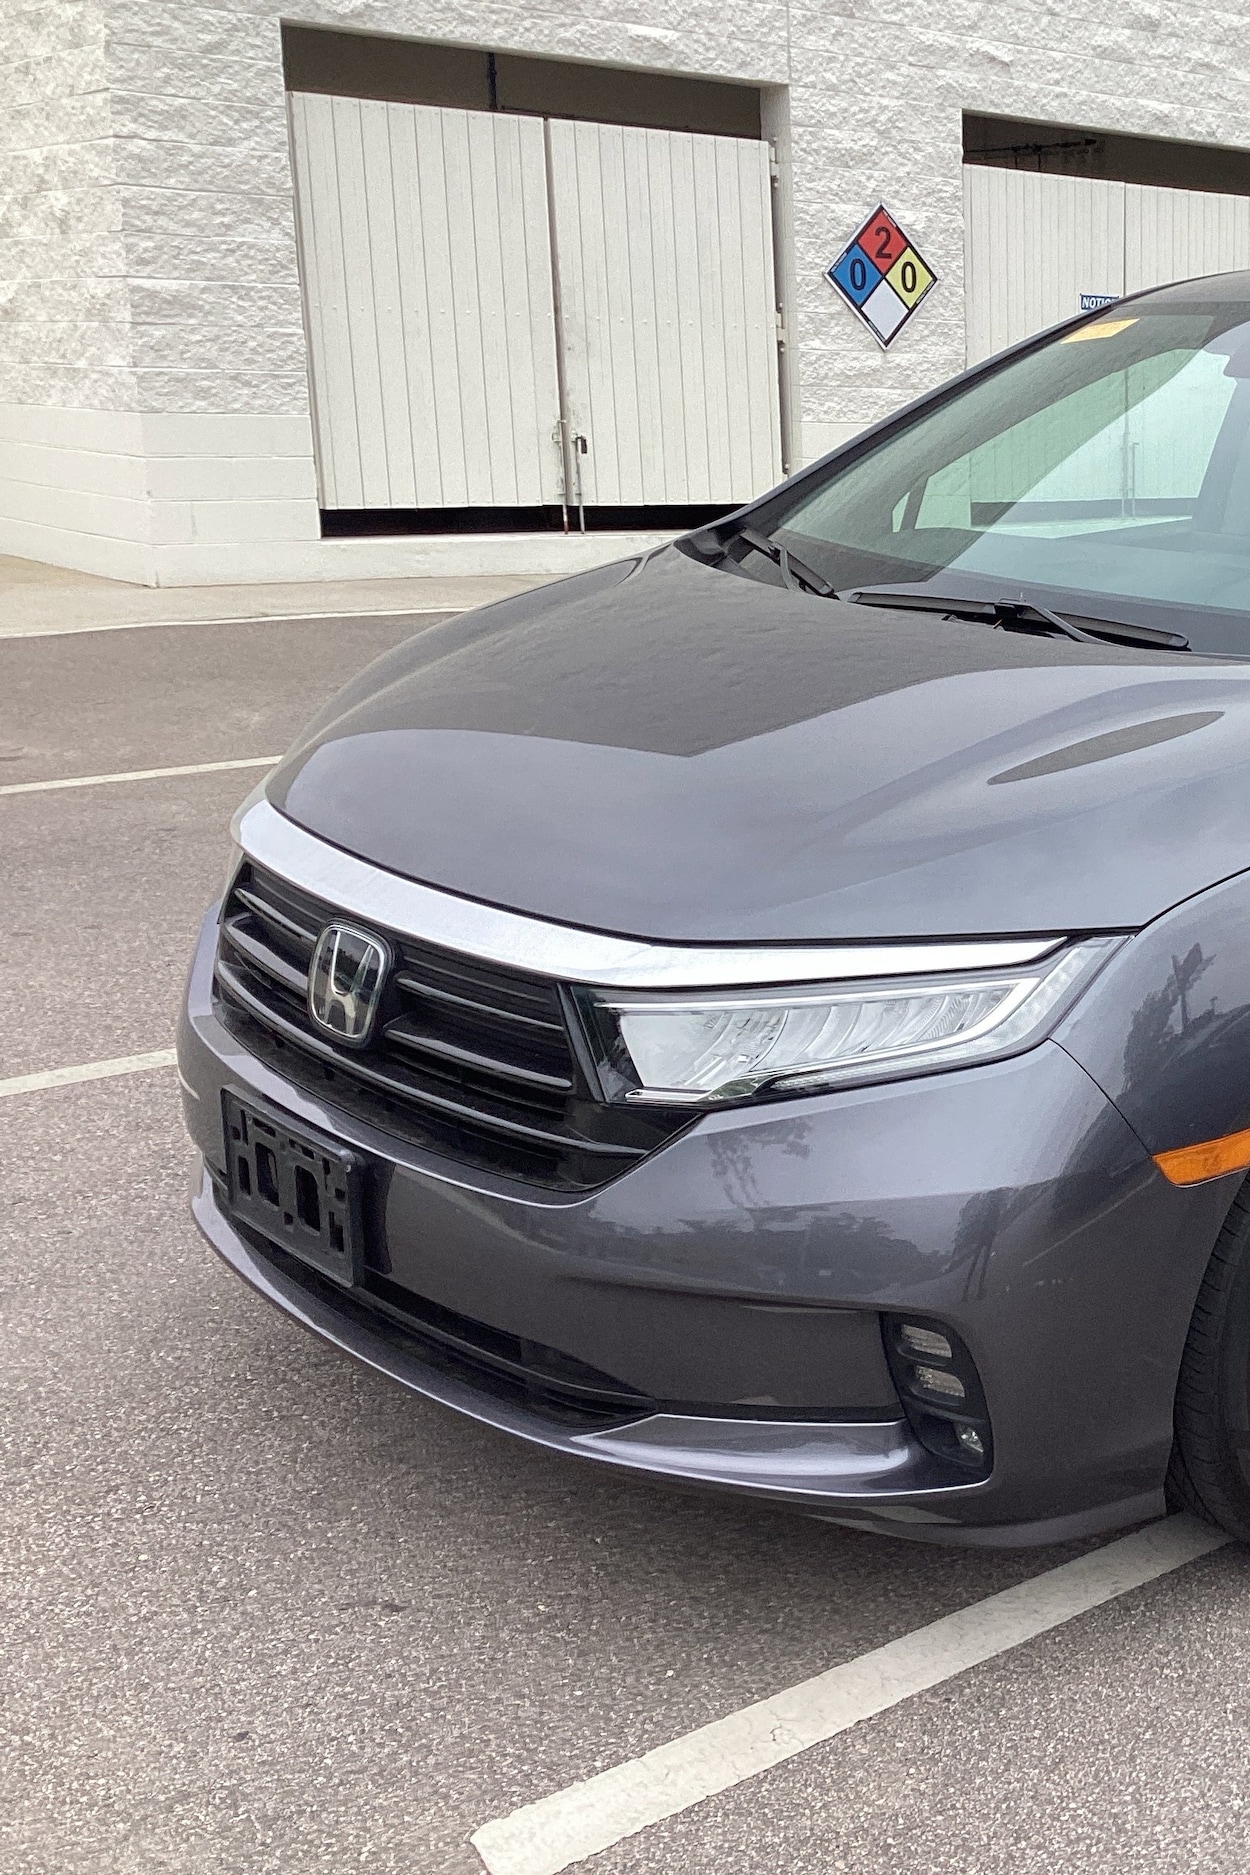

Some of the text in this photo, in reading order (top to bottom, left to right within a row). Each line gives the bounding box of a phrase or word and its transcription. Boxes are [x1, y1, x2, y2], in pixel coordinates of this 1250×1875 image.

[874, 226, 892, 259] 2
[850, 258, 866, 291] 0
[901, 261, 917, 293] 0
[1081, 296, 1118, 309] NOTIC
